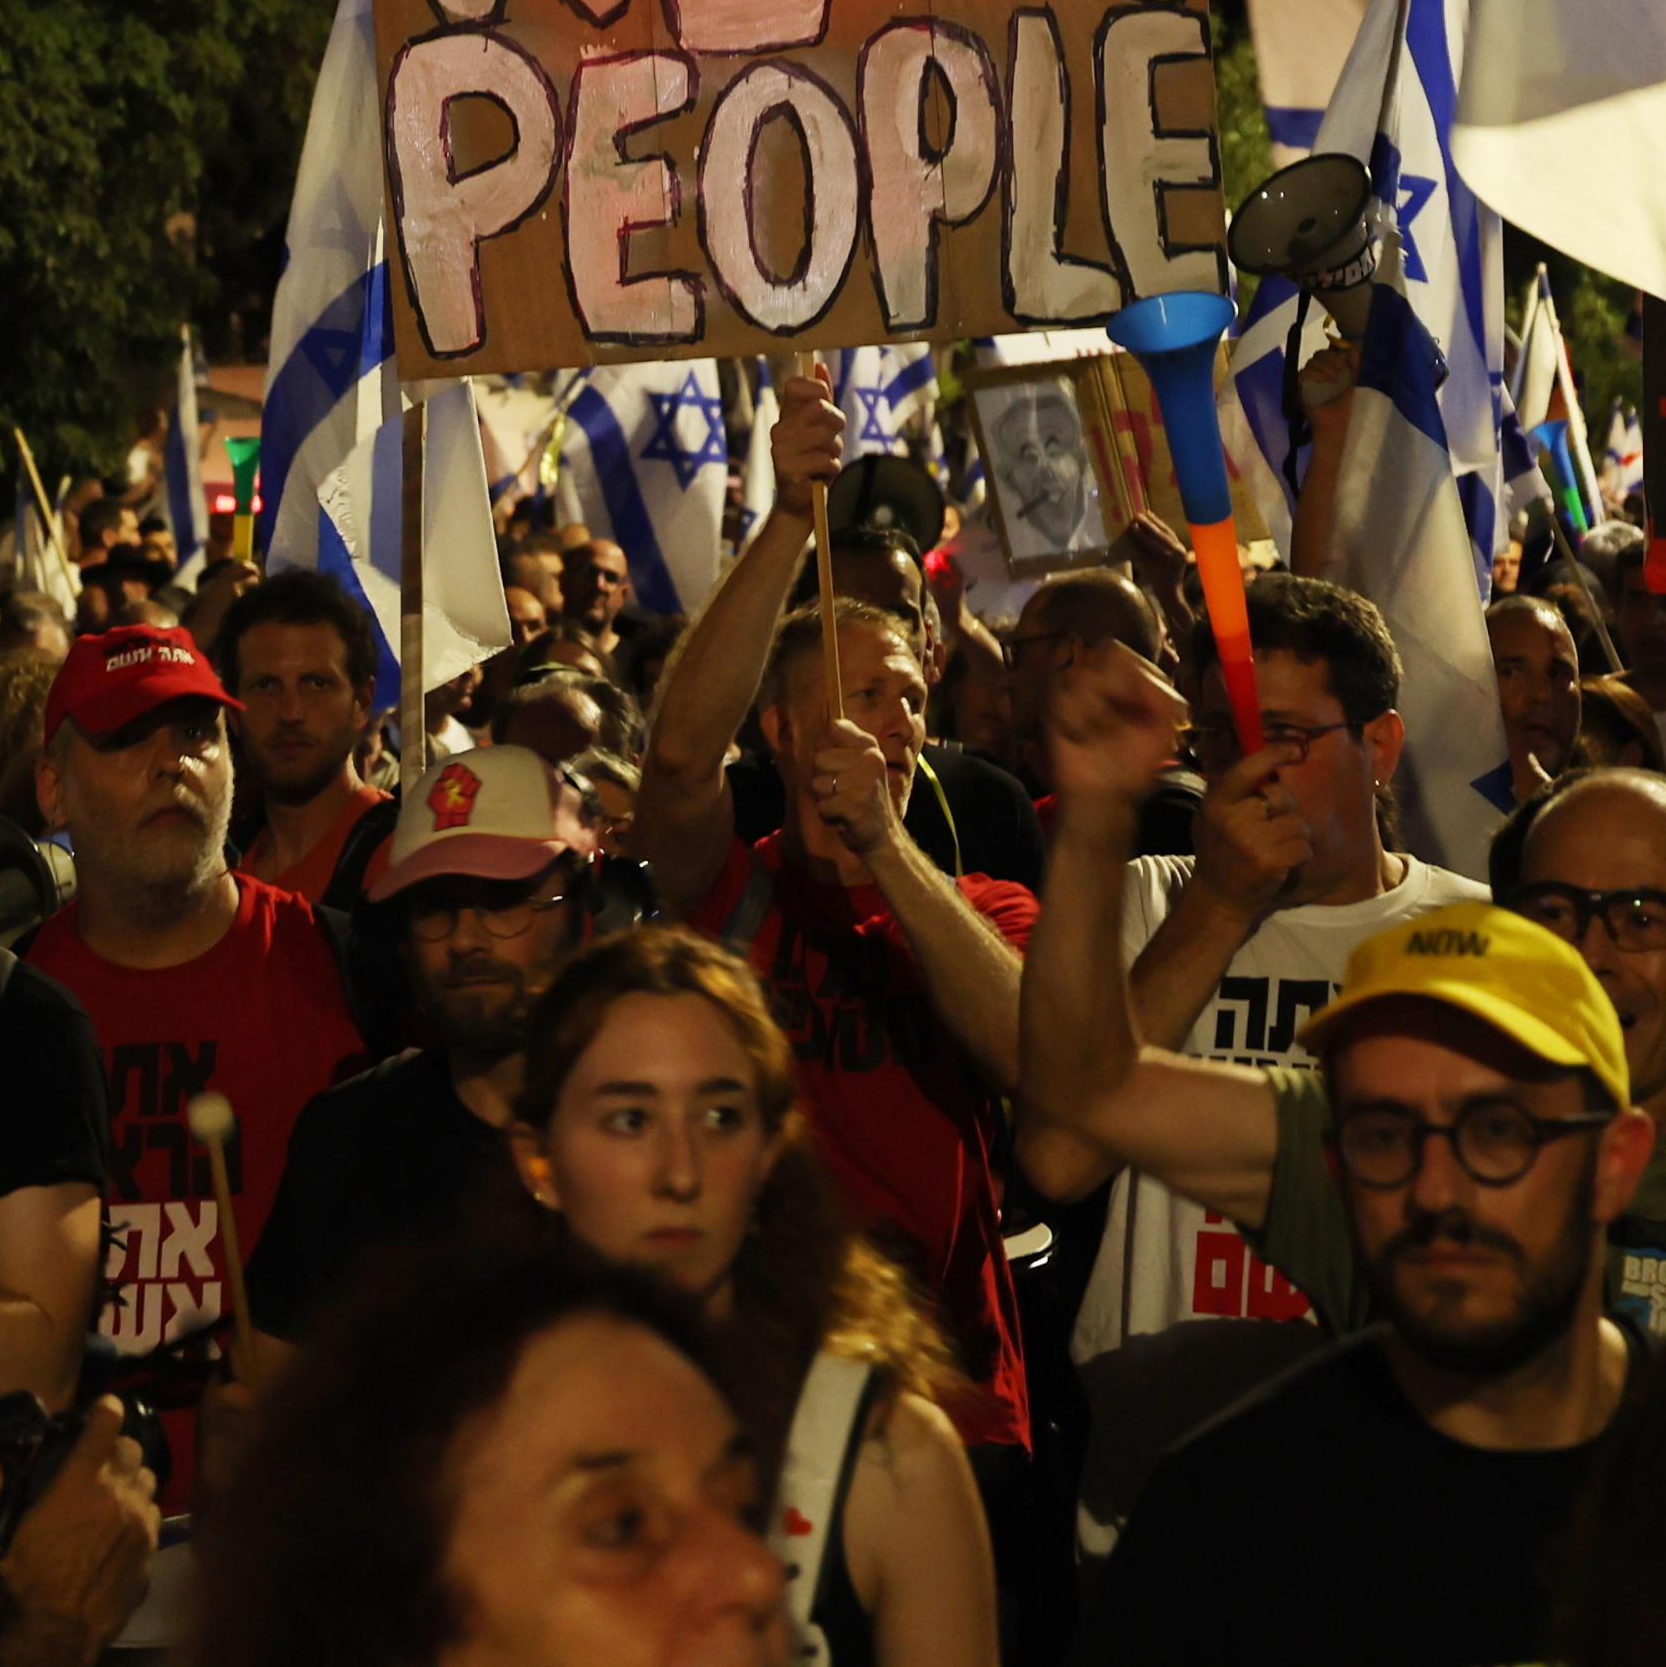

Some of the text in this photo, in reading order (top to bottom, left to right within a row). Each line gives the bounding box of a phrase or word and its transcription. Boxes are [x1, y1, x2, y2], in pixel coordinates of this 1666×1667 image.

[386, 3, 1229, 360] PEOPLE
[1215, 976, 1332, 1056] תה
[110, 1040, 219, 1118] את
[107, 1119, 243, 1200] הרא
[104, 1200, 219, 1280] את
[96, 1281, 223, 1361] אש
